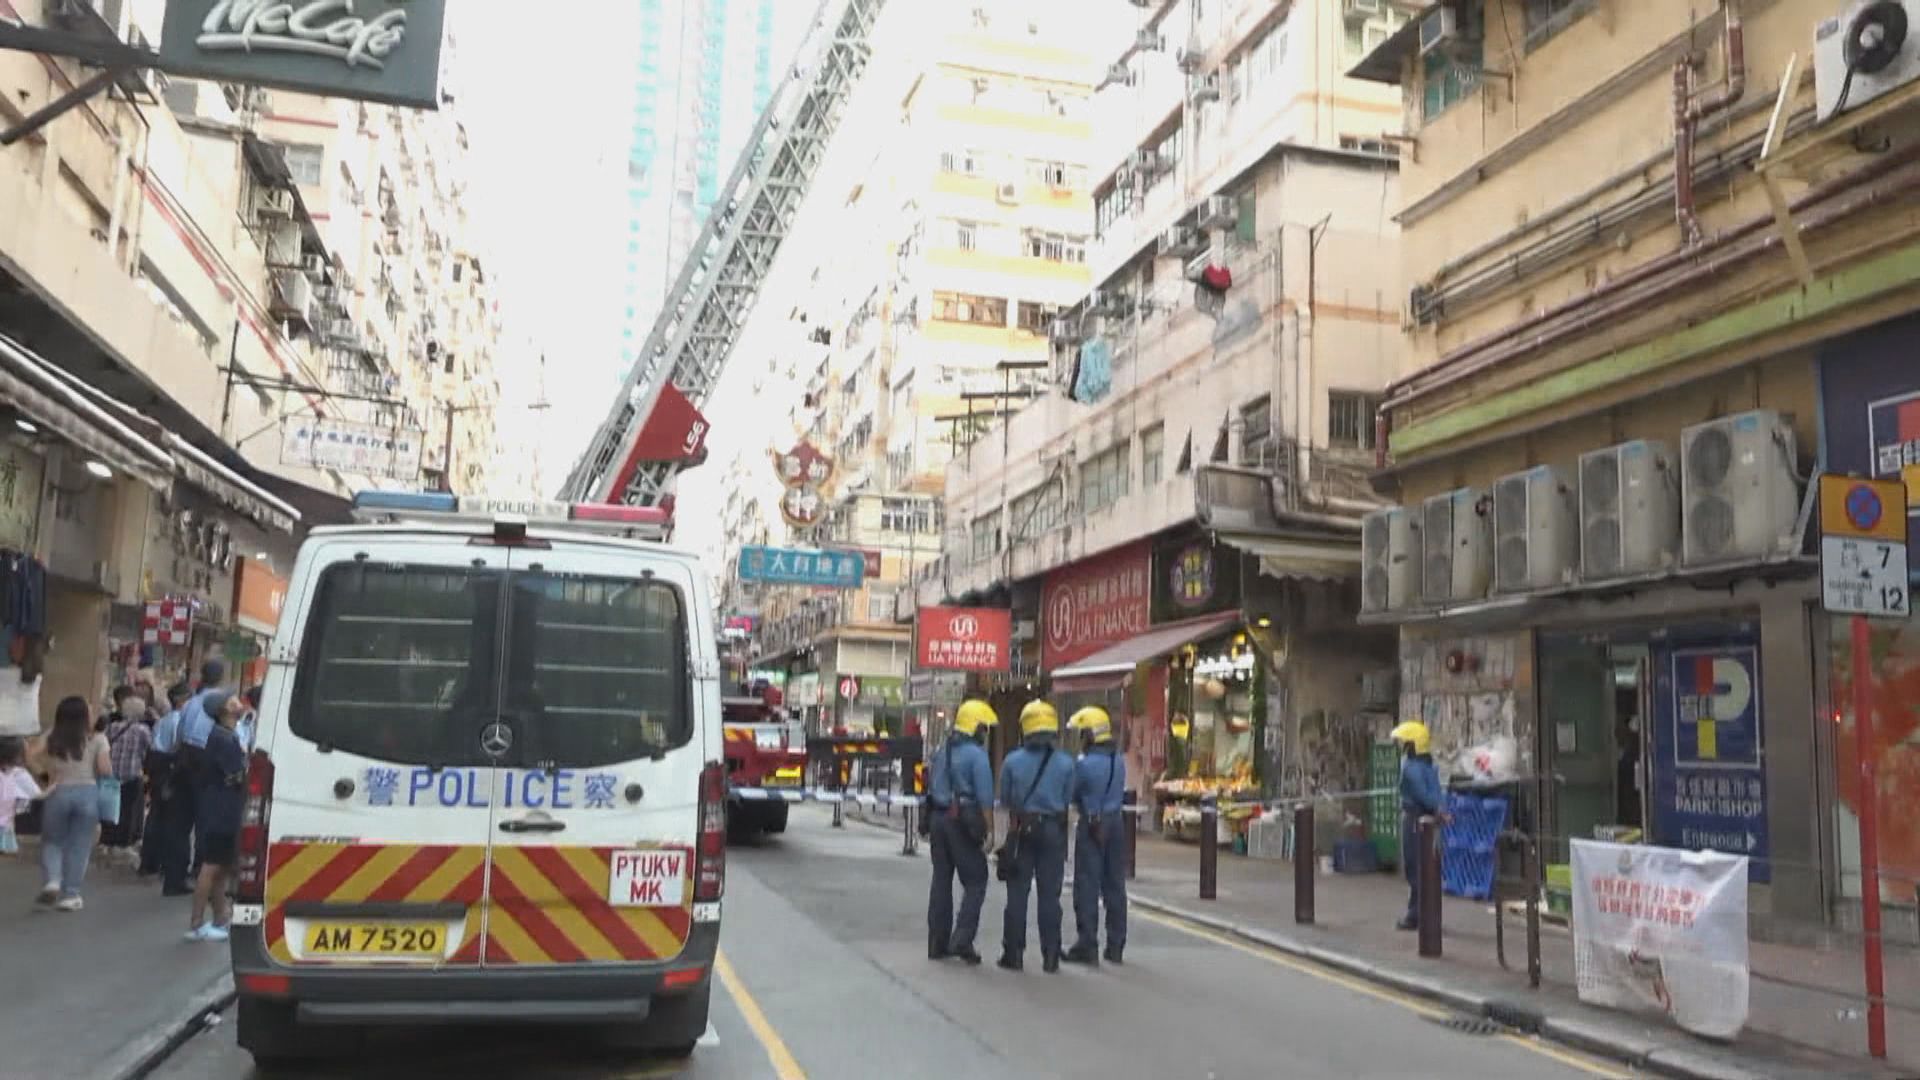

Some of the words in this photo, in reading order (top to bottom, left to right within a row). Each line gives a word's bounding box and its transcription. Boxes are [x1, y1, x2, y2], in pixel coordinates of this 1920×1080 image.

[1877, 546, 1890, 569] 7
[1880, 586, 1905, 611] 12
[1094, 604, 1144, 638] FINANCE
[928, 651, 945, 664] UA
[948, 652, 998, 667] FINANCE
[365, 767, 399, 807] 警
[583, 772, 618, 809] 察
[616, 854, 681, 878] PTUKW
[630, 880, 663, 903] MK
[312, 926, 352, 951] AM
[360, 926, 437, 951] 7520
